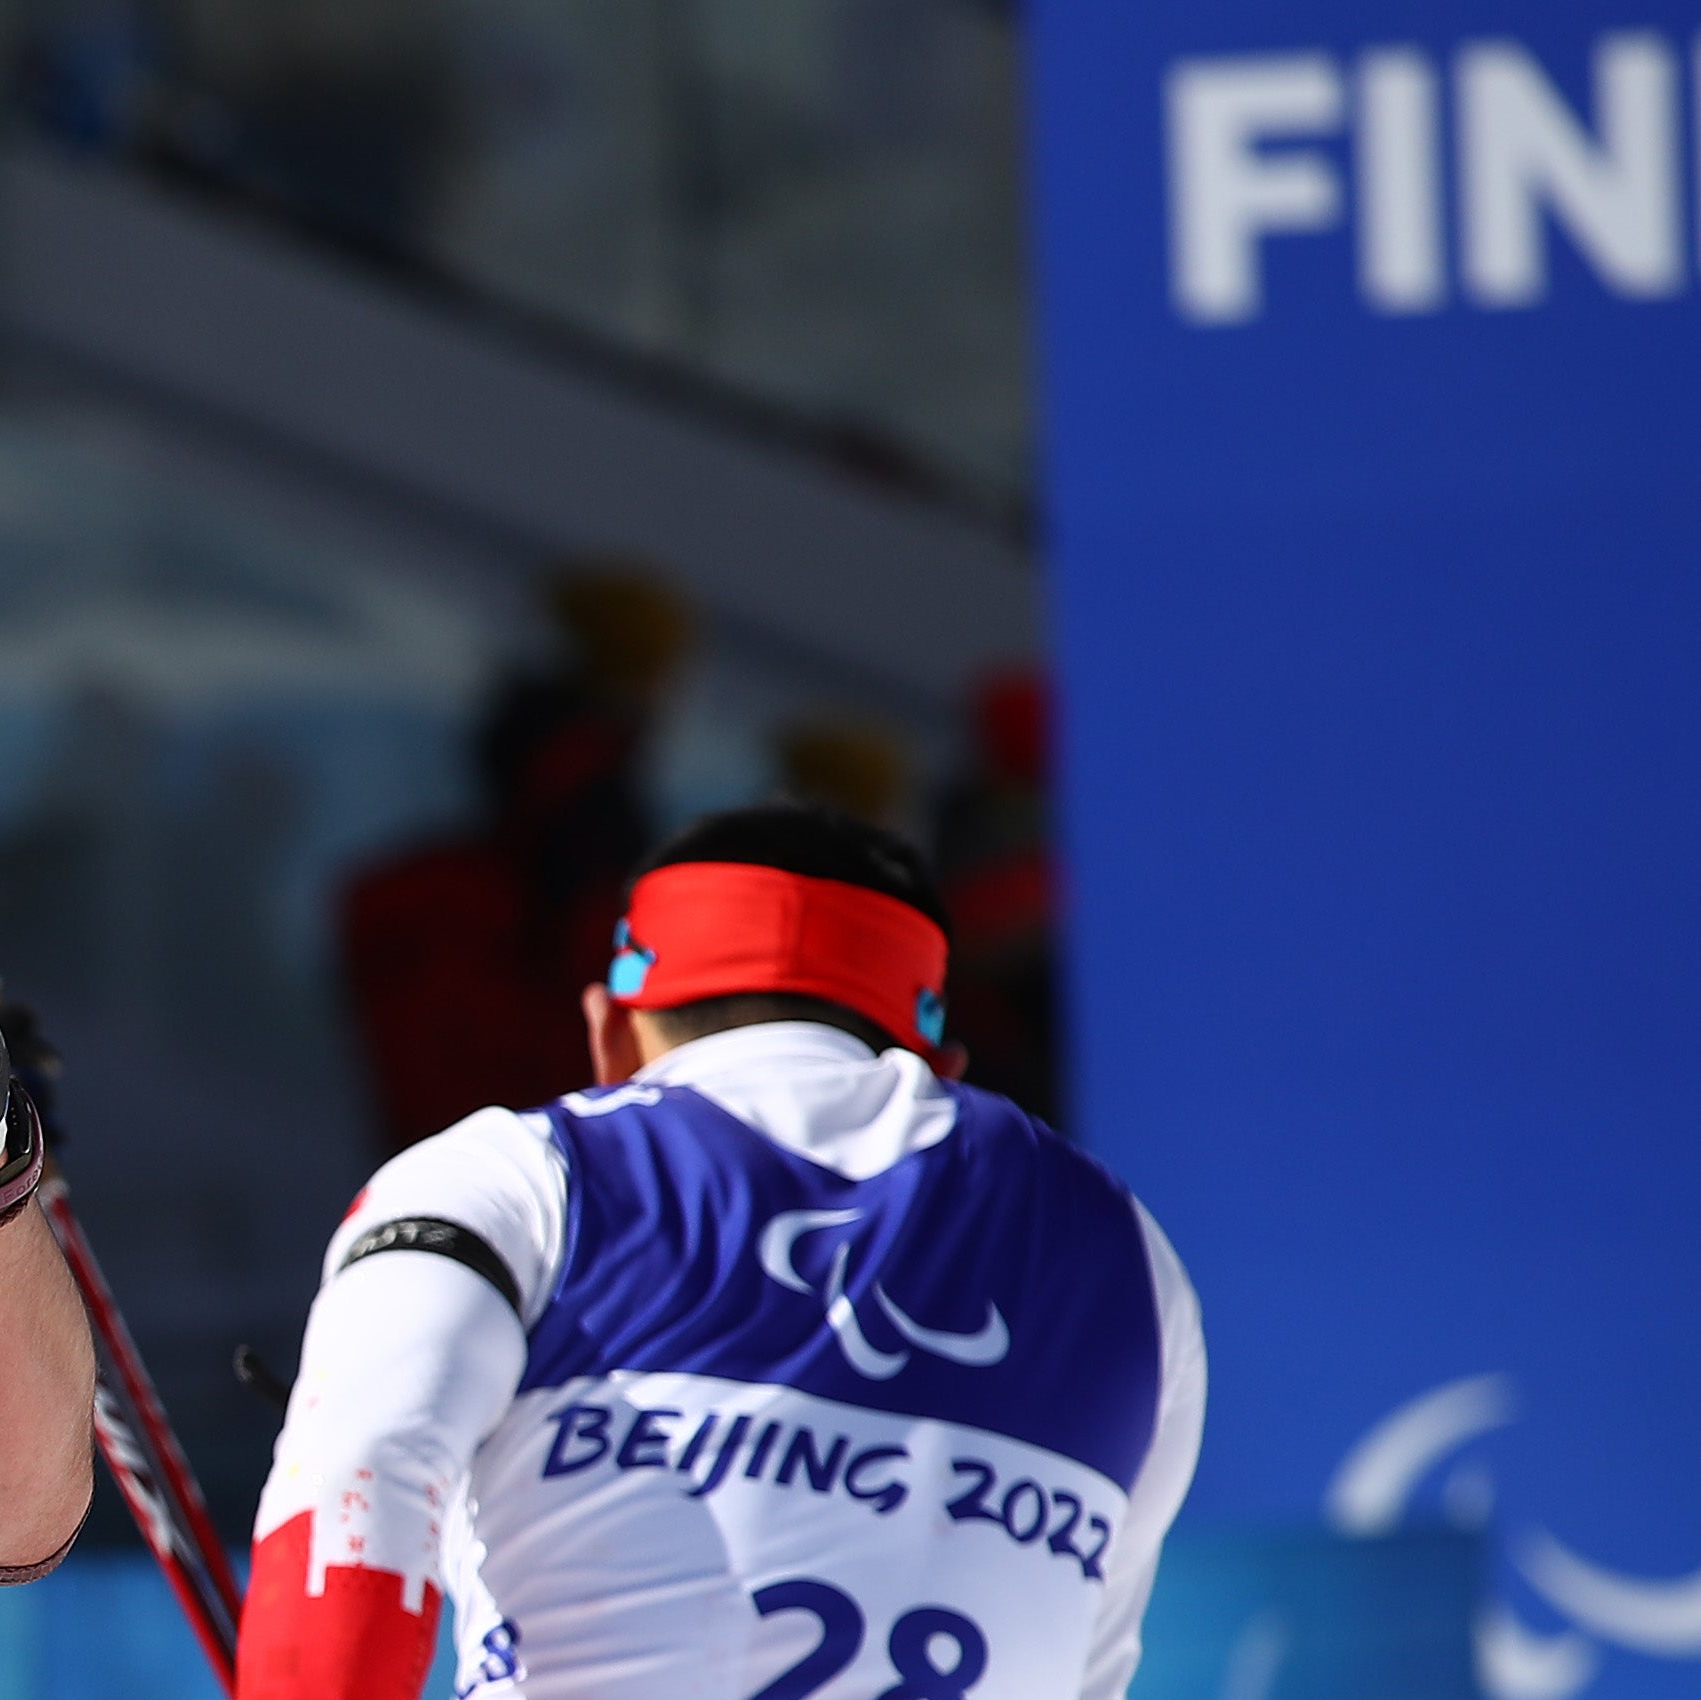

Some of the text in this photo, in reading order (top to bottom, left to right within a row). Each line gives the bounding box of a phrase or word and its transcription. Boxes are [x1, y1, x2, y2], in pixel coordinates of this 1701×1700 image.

[1169, 32, 1701, 324] FIN
[540, 1404, 1113, 1585] BEIJING 2022
